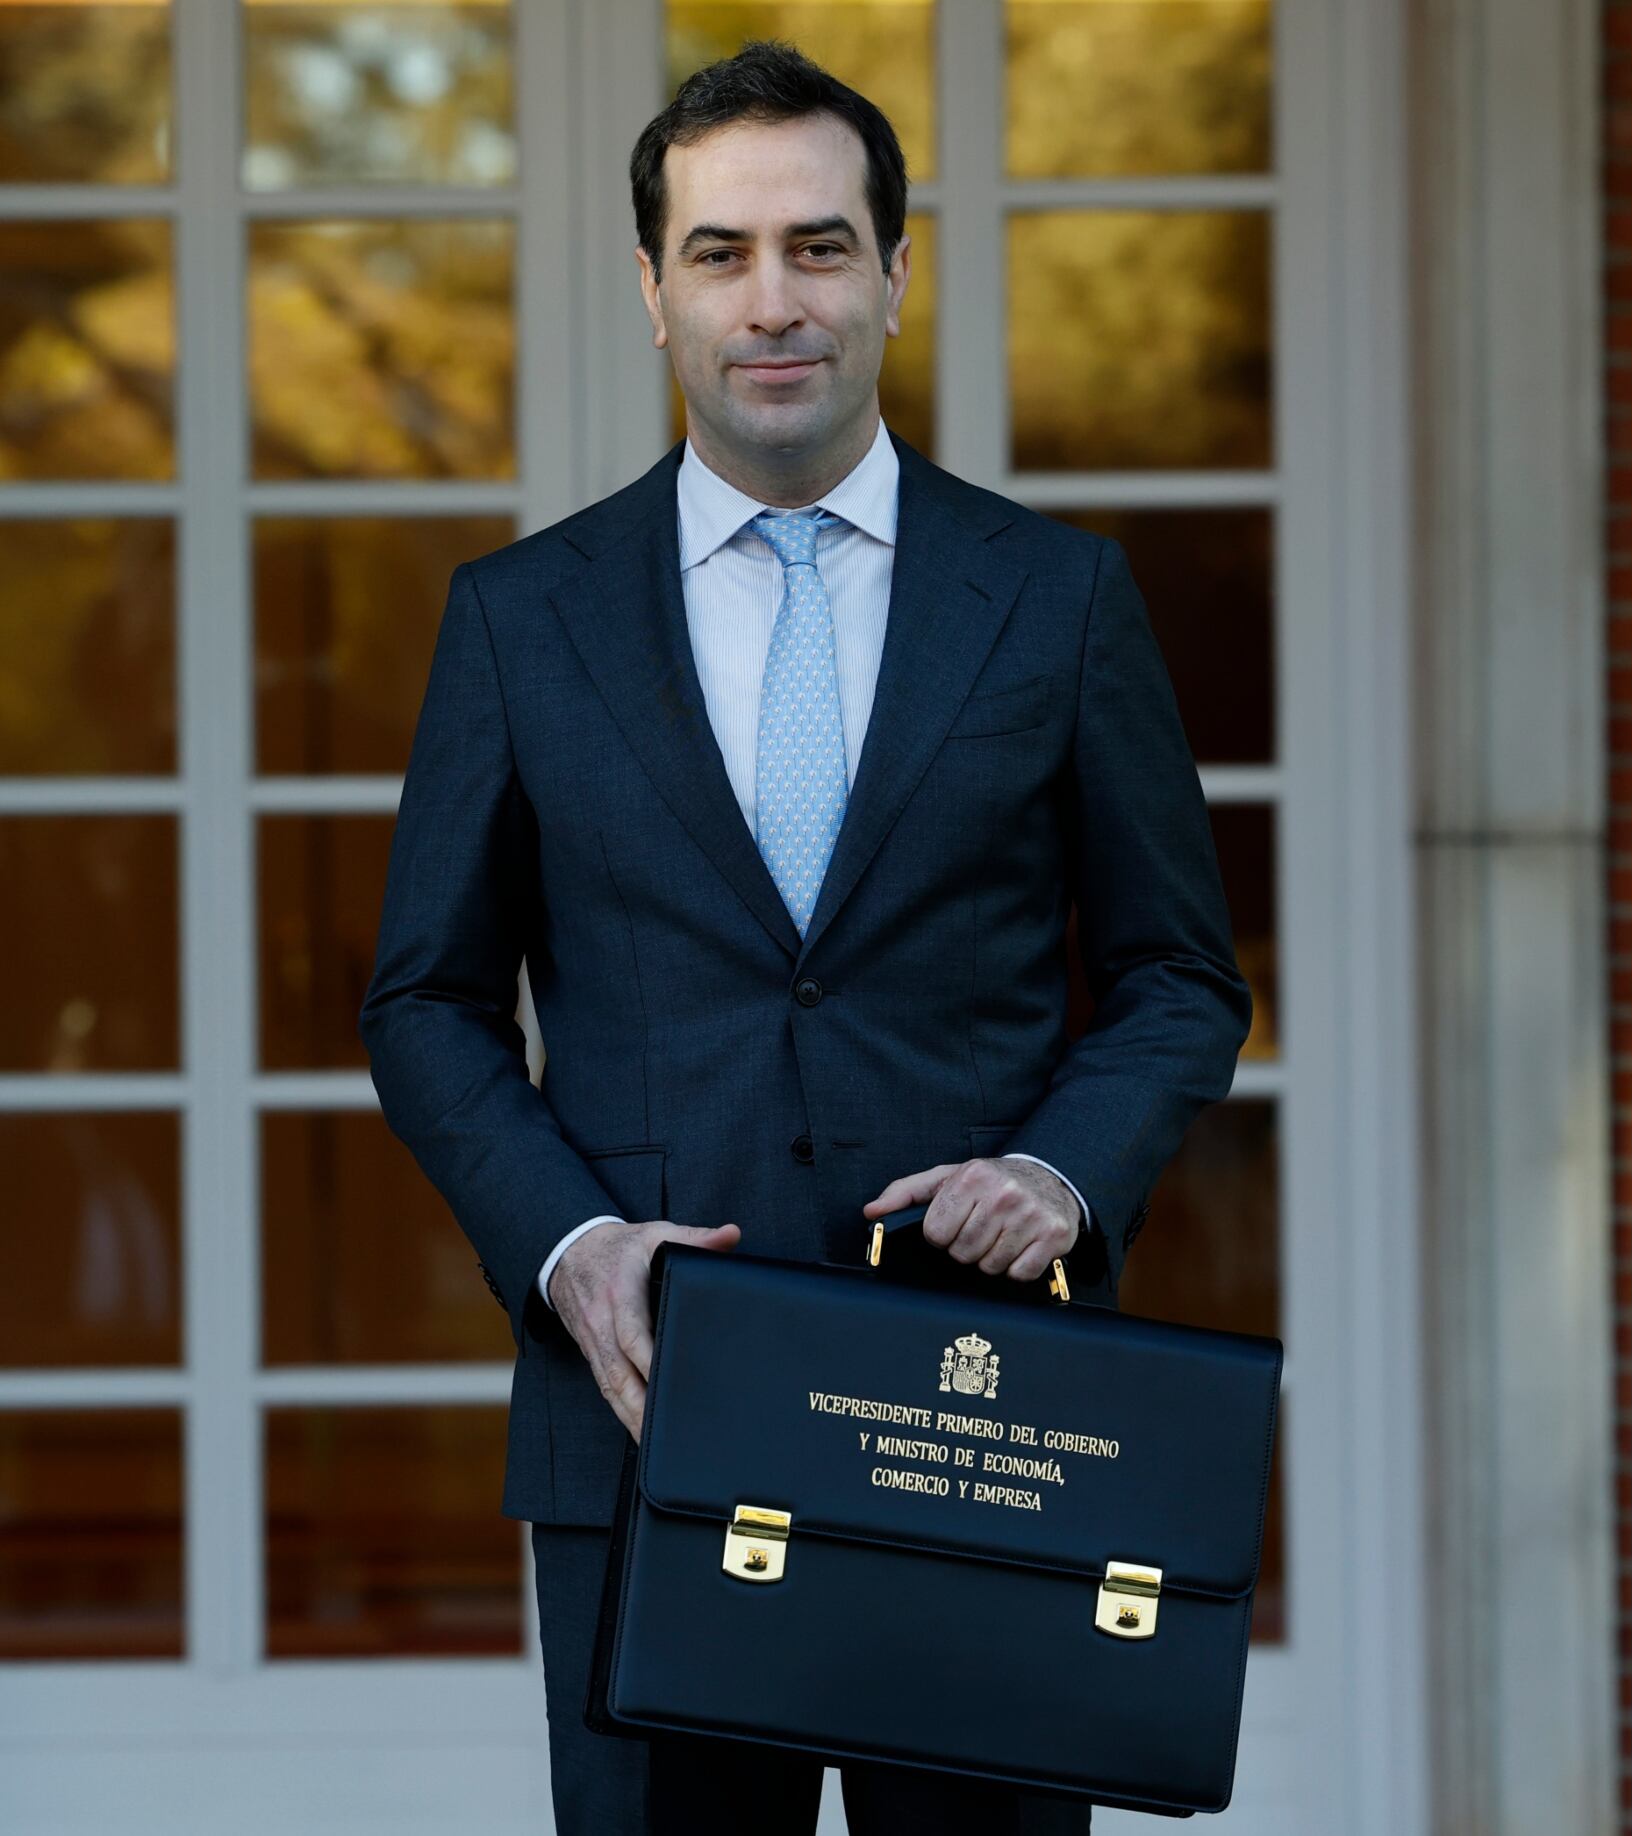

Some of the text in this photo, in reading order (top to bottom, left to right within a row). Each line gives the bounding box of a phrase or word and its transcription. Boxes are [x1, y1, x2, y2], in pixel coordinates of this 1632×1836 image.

[808, 1391, 1120, 1459] VICEPRESIDENTE PRIMERO DEL GOBIERNO
[859, 1432, 1065, 1487] Y MINISTRO DE ECONOMÍA,
[871, 1467, 1042, 1512] COMERCIO Y EMPRESA
